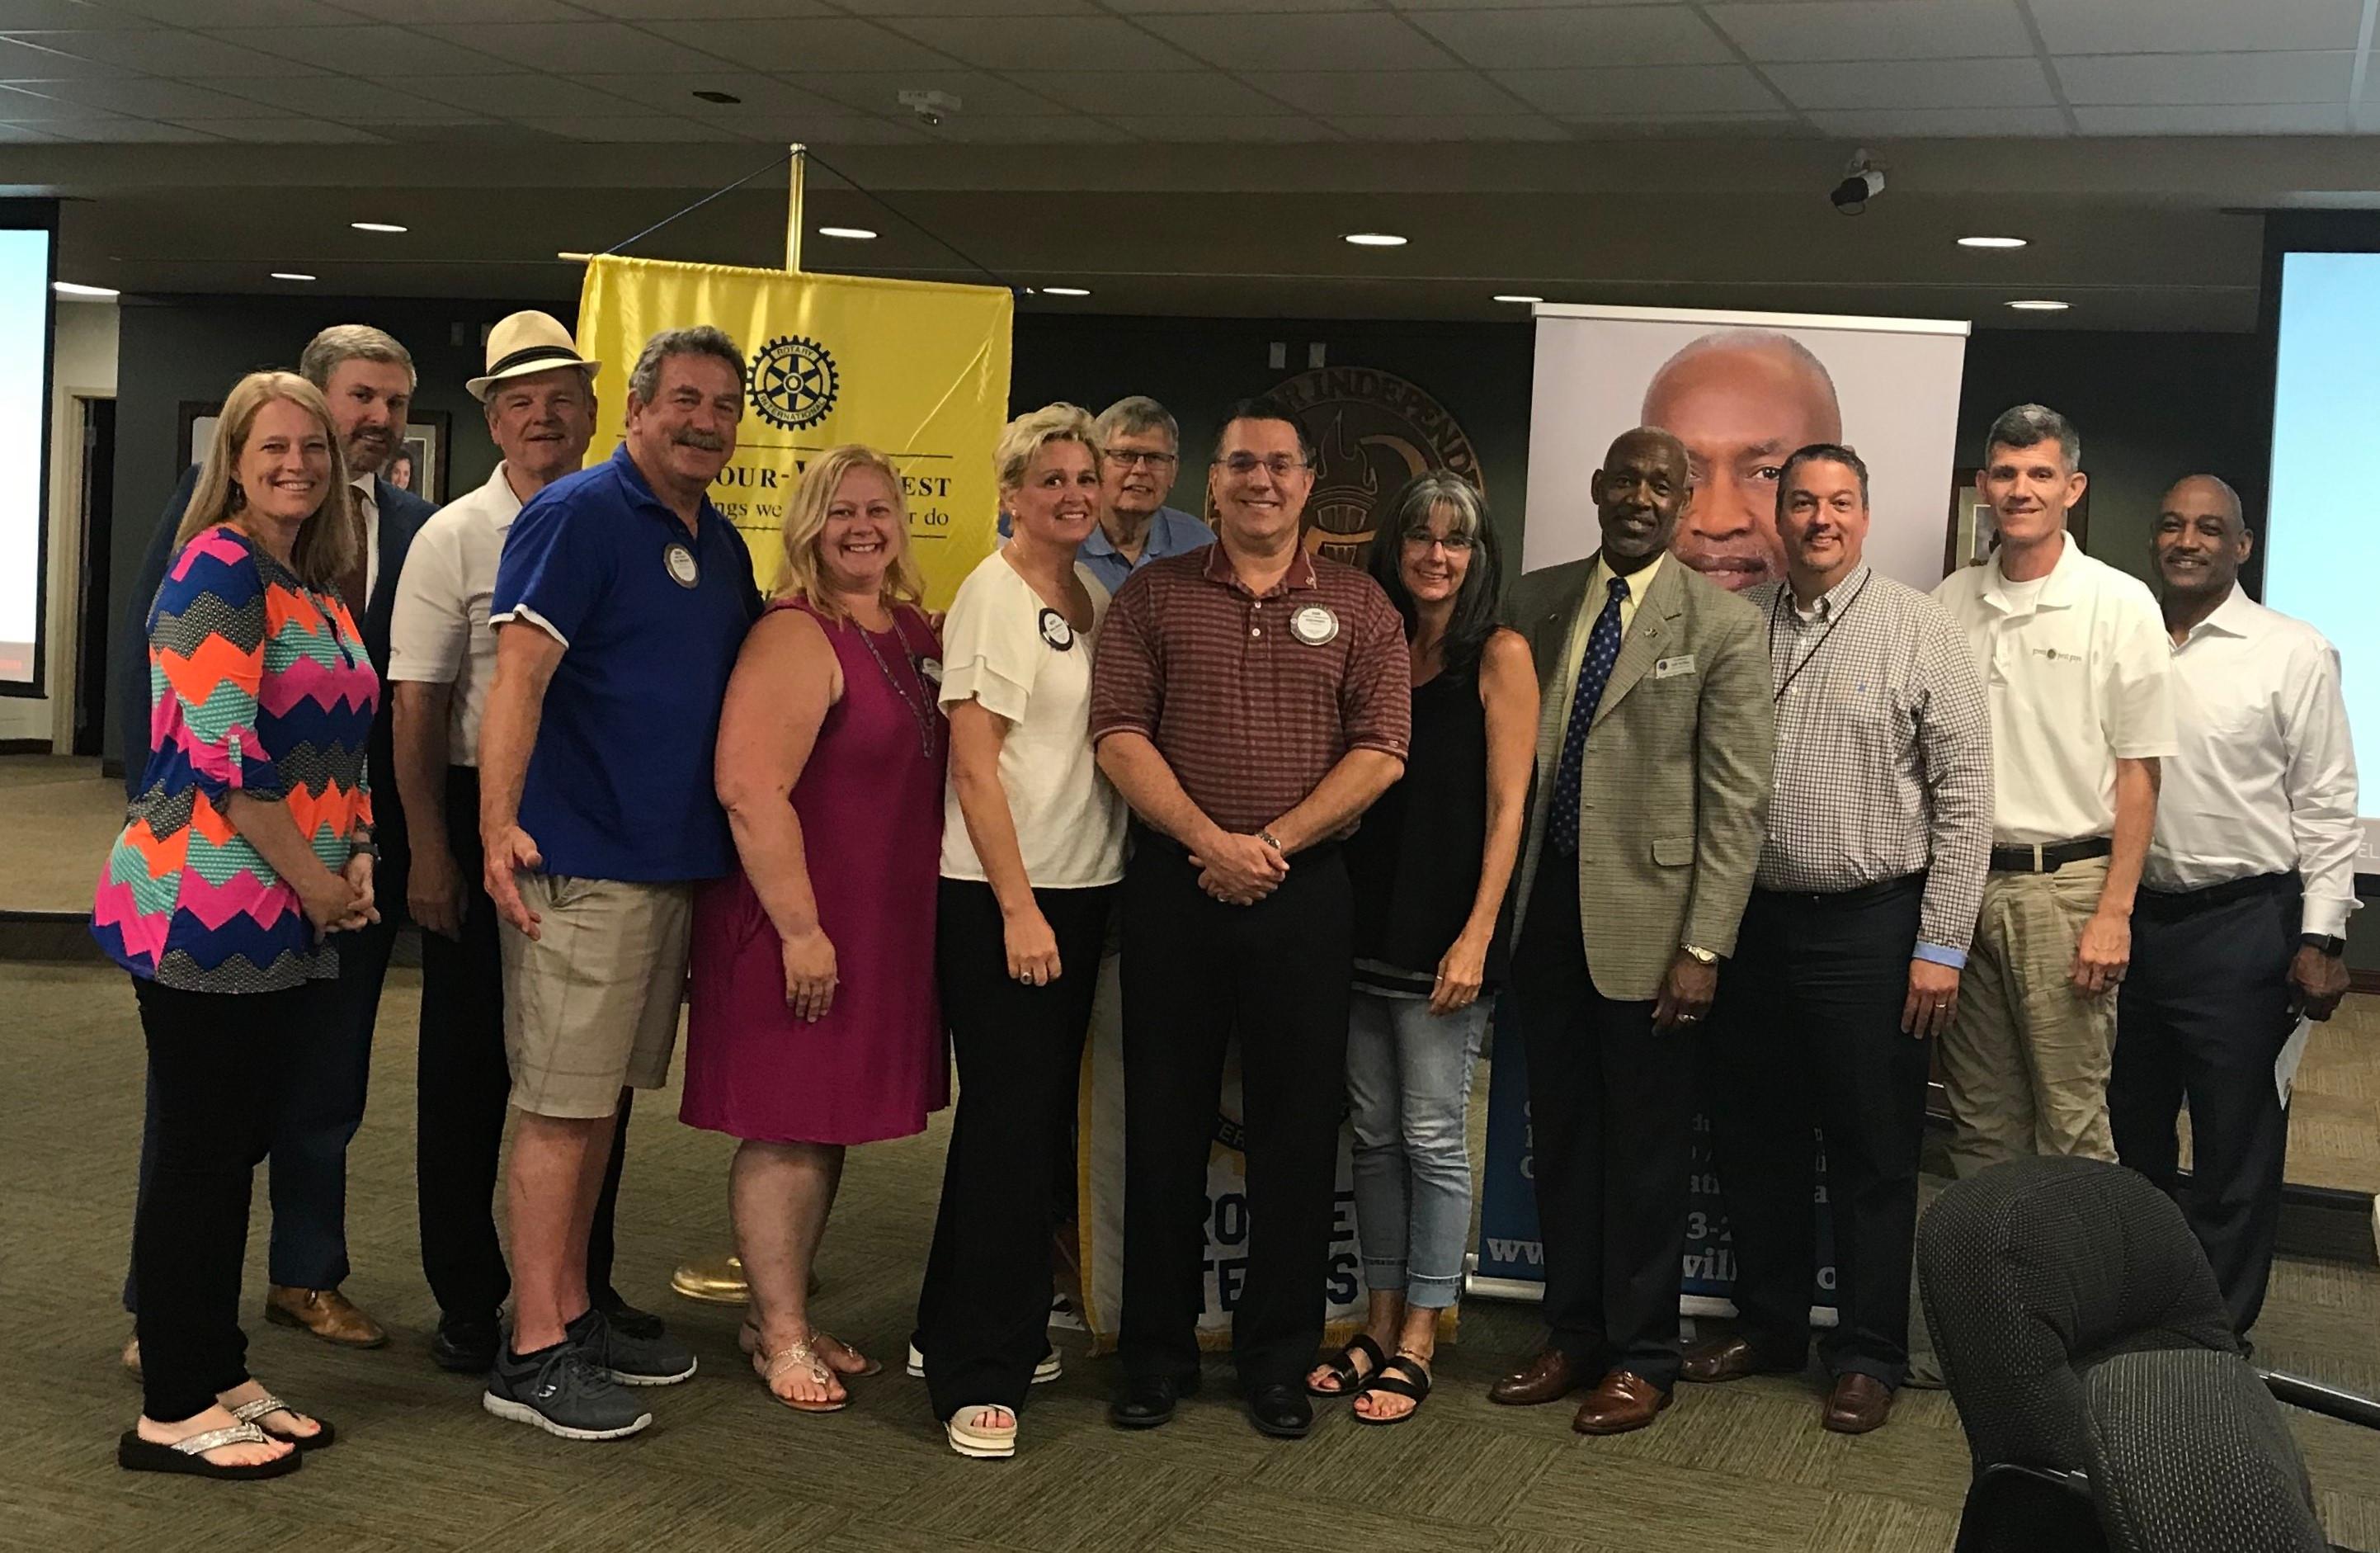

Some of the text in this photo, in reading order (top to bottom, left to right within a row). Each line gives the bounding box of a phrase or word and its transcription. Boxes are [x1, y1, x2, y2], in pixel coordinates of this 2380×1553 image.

[776, 345, 813, 356] ROTARY
[759, 395, 826, 422] INTERNATIONAL
[1310, 370, 1484, 485] INDEPEND
[899, 474, 952, 497] EST
[714, 502, 747, 521] ngs
[756, 503, 783, 518] we
[924, 507, 949, 526] do
